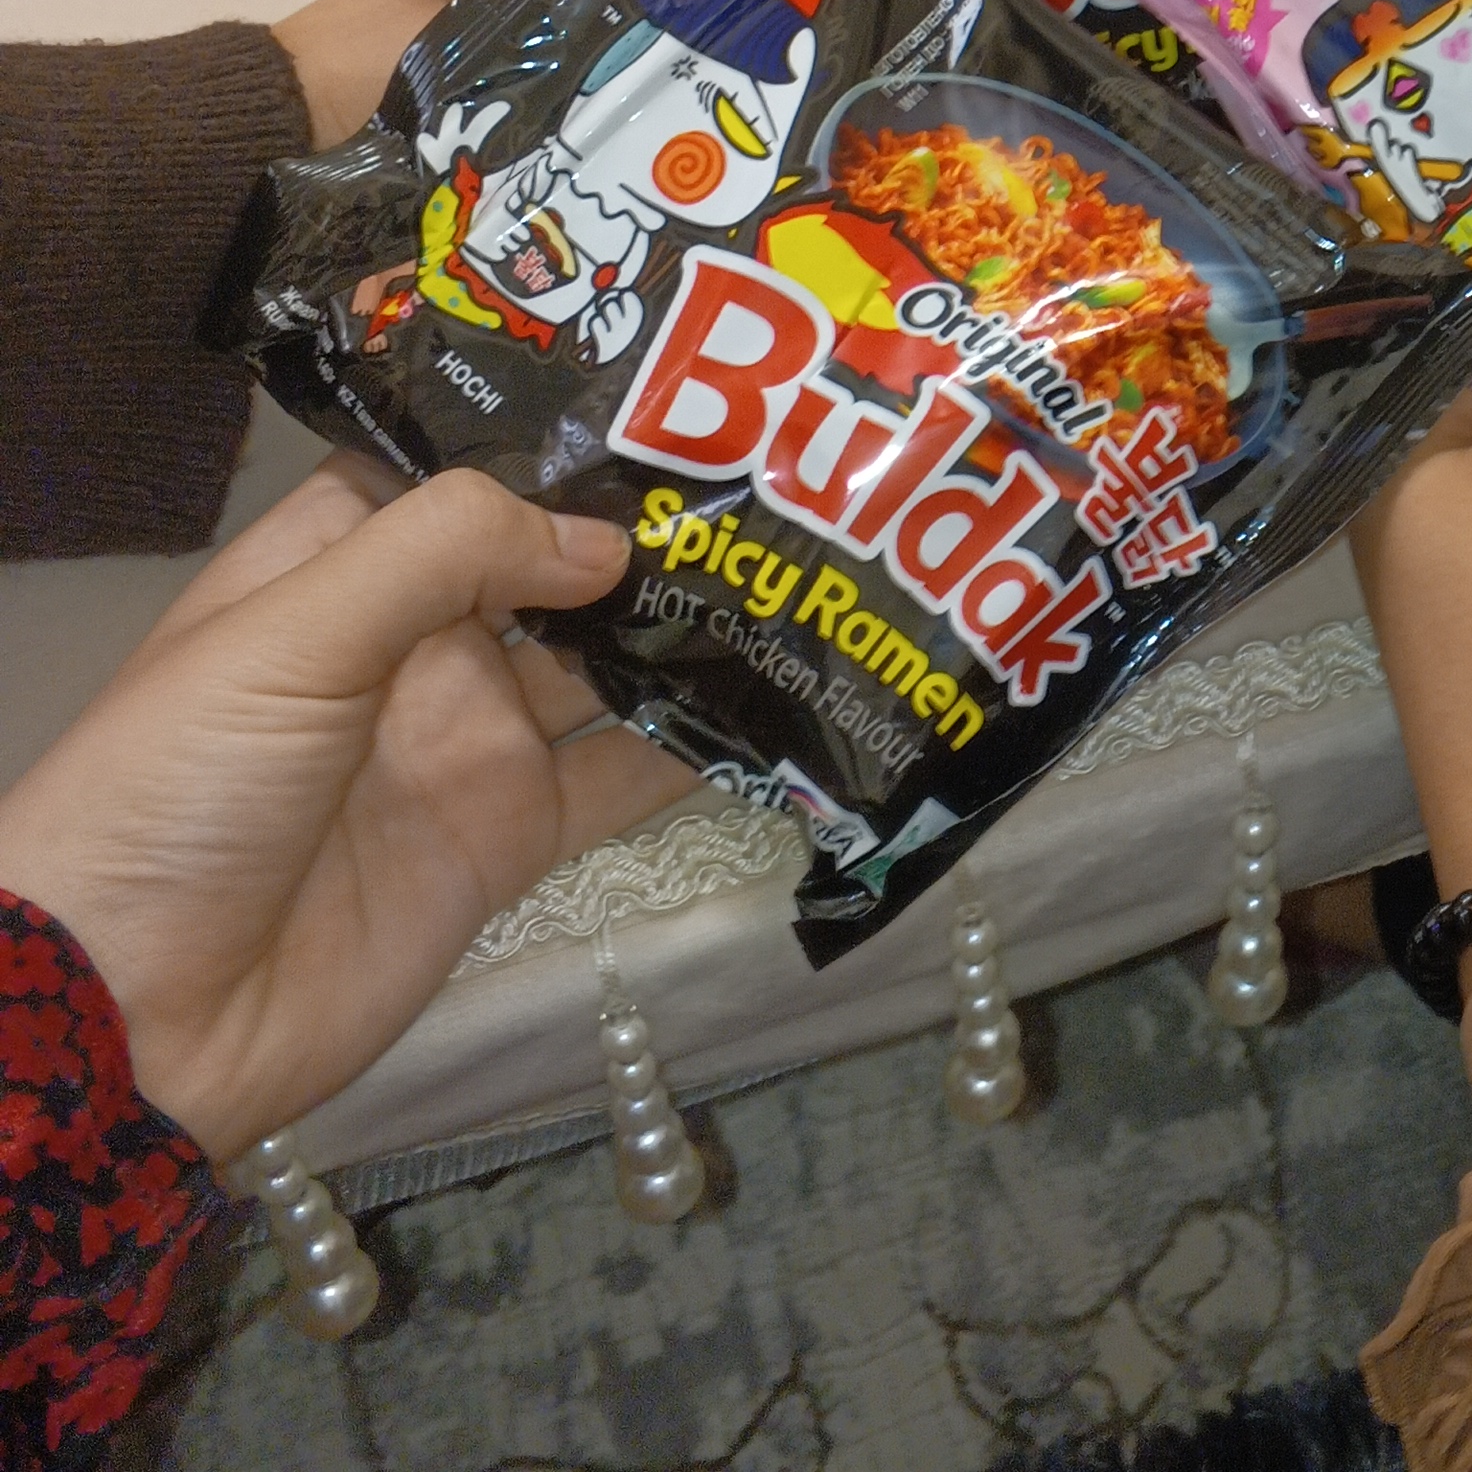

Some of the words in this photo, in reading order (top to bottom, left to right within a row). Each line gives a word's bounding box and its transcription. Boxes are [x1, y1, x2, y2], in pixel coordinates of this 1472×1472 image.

[434, 350, 504, 414] HOCHI
[894, 281, 1113, 442] Original
[607, 244, 1112, 708] Buldak
[1077, 406, 1217, 589] 불닭
[633, 577, 705, 624] HOT
[814, 677, 924, 774] Flavour
[635, 487, 804, 618] Spicy
[793, 564, 985, 751] Ramen
